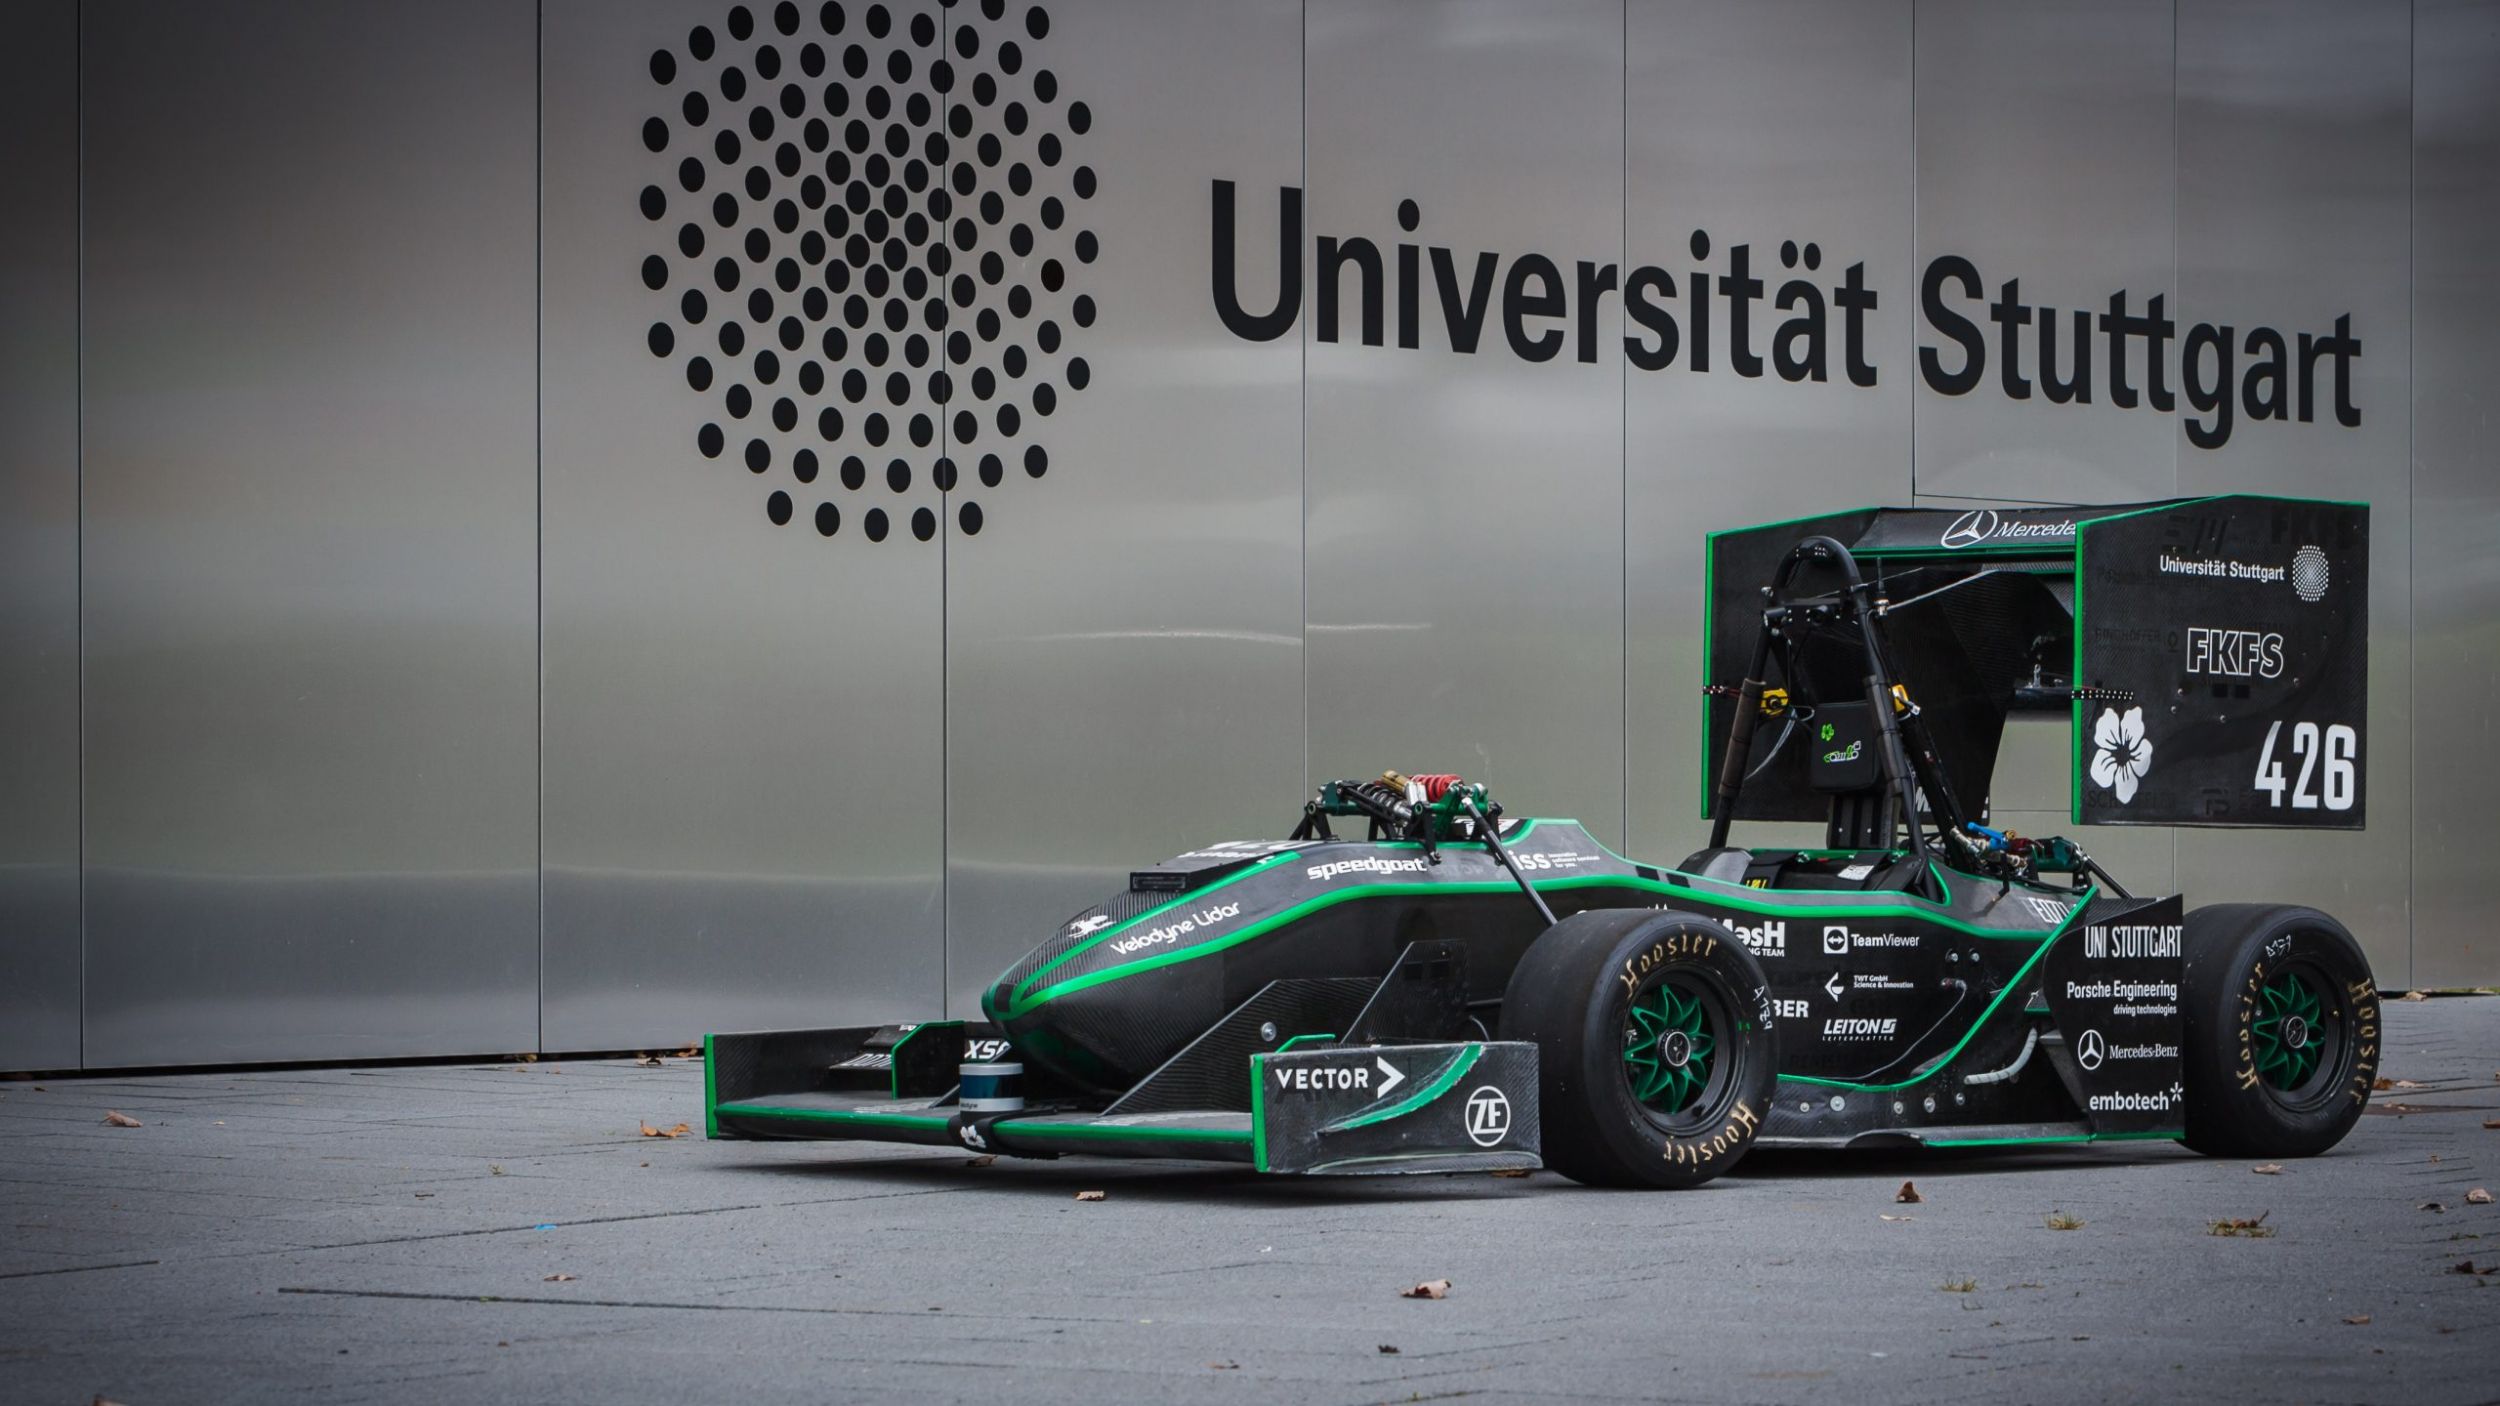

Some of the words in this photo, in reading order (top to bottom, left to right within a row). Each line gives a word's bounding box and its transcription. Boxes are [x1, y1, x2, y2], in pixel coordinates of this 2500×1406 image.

[1211, 180, 1878, 388] Universität
[1918, 255, 2362, 450] Stuttgart
[1993, 519, 2076, 538] Mercede
[2160, 554, 2226, 577] Universität
[2229, 560, 2285, 583] Stuttgart
[2186, 627, 2284, 679] FKFS
[2254, 720, 2356, 811] 426
[1306, 856, 1428, 881] speedgoat
[1110, 914, 1195, 955] Velodyne
[1192, 902, 1241, 927] Lidar
[1850, 933, 1920, 947] TeamViewer
[1762, 947, 1785, 958] TEAM
[2084, 925, 2107, 958] UNI
[2112, 925, 2184, 958] STUTTGART
[1620, 924, 1718, 999] Hoosier
[2066, 980, 2112, 999] Porsche
[2113, 980, 2178, 1001] Engineering
[1772, 999, 1809, 1018] BER
[2113, 1003, 2136, 1017] driving
[2136, 1003, 2177, 1017] technologies
[1824, 1018, 1882, 1034] LEITON
[2109, 1043, 2179, 1060] Mercedes-Benz
[1275, 1067, 1369, 1090] VECTOR
[1469, 1098, 1506, 1136] ZF
